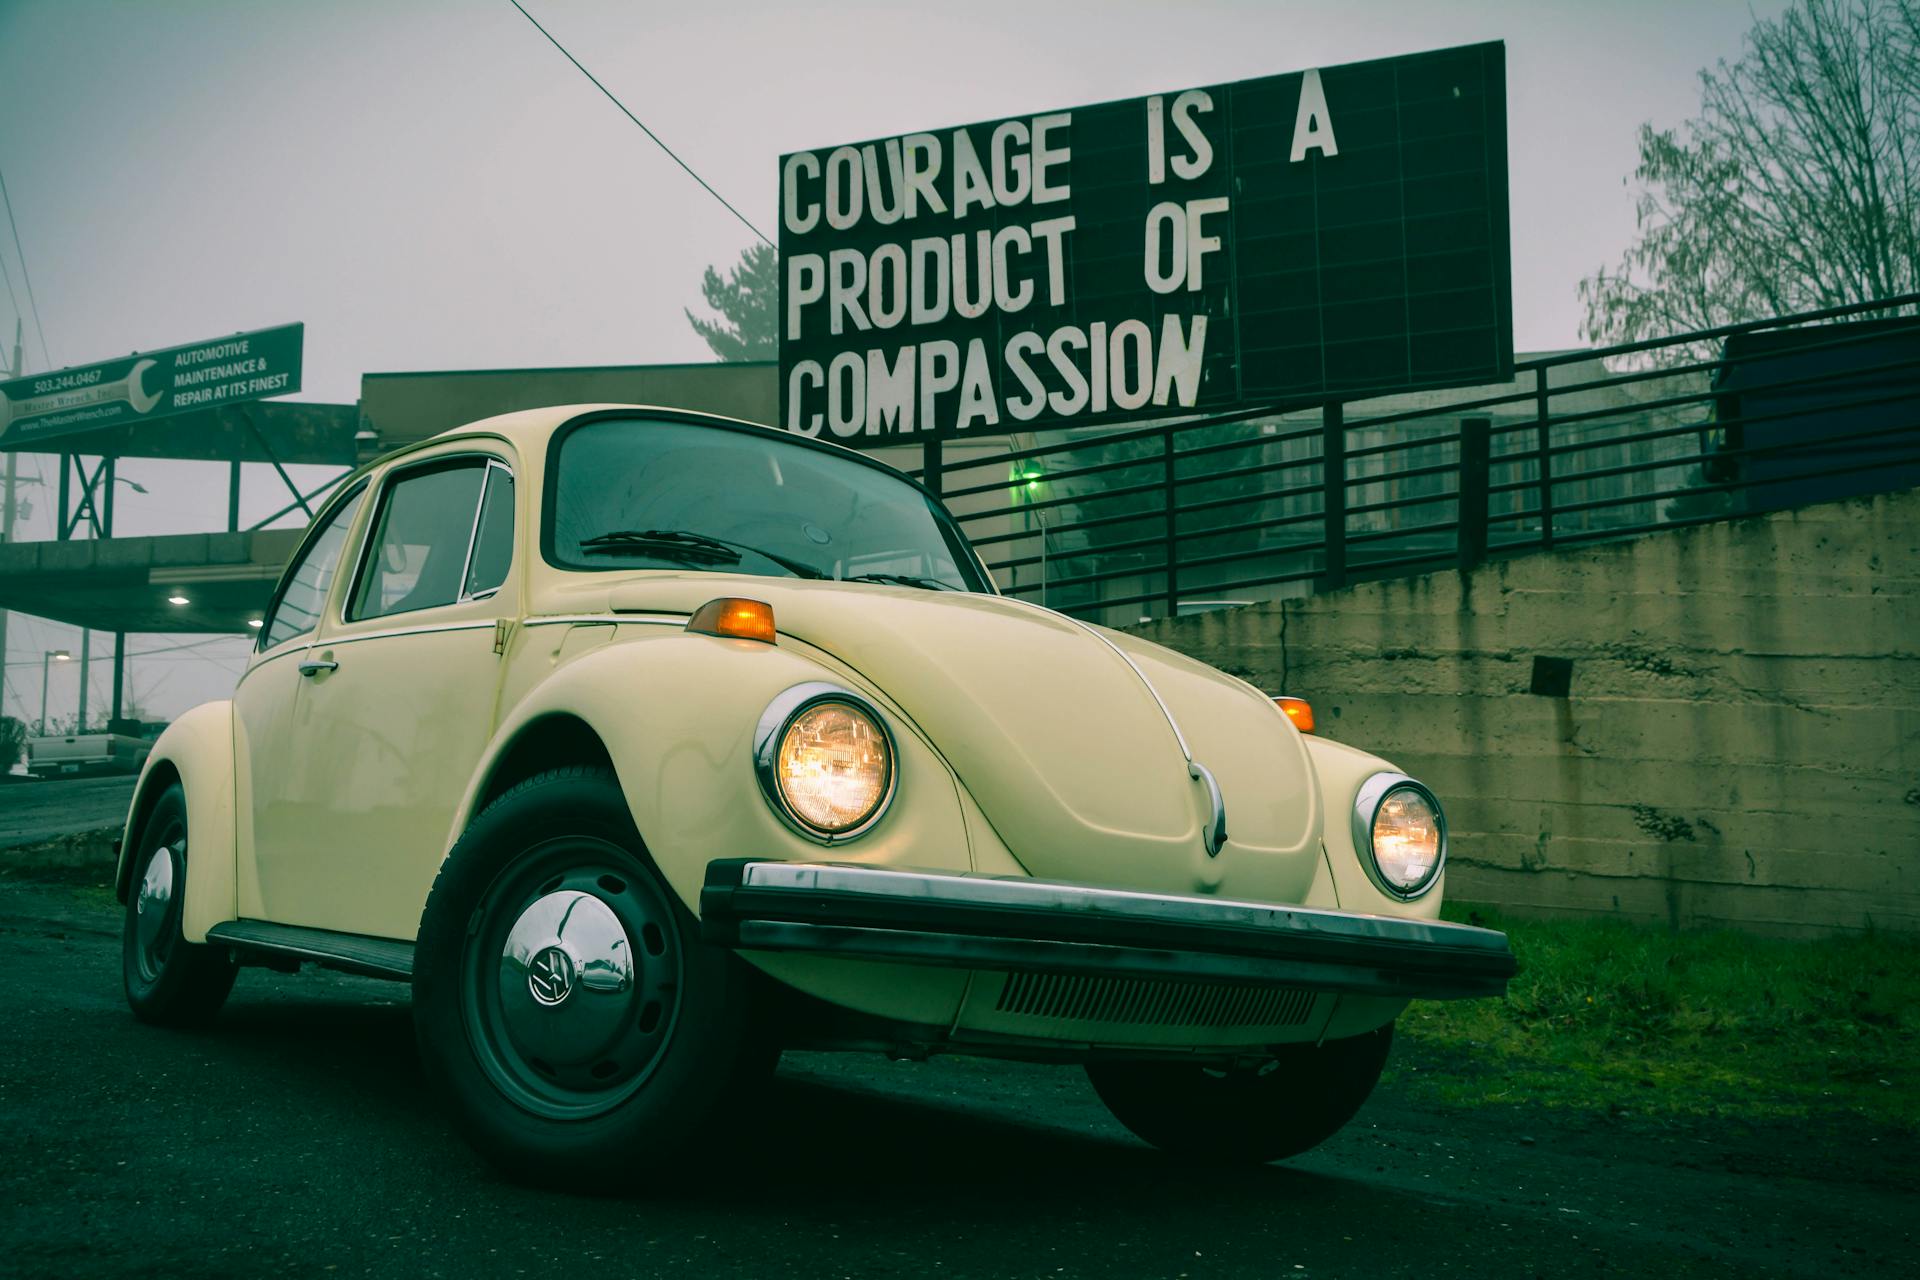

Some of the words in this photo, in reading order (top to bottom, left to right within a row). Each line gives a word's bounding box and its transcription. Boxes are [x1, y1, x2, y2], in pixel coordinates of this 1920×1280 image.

[783, 112, 1072, 234] COURAGE
[1147, 89, 1214, 184] IS
[1290, 68, 1338, 162] A
[787, 215, 1076, 341] PRODUCT
[1144, 196, 1230, 294] OF
[174, 340, 249, 367] AUTOMOTIVE
[34, 369, 102, 394] 503.244.0467
[174, 360, 256, 387] MAINTENANCE
[257, 357, 267, 371] &
[787, 313, 1208, 439] COMPASSION
[173, 388, 213, 407] REPAIR
[214, 384, 229, 399] AT
[229, 381, 247, 397] ITS
[248, 373, 289, 392] FINEST
